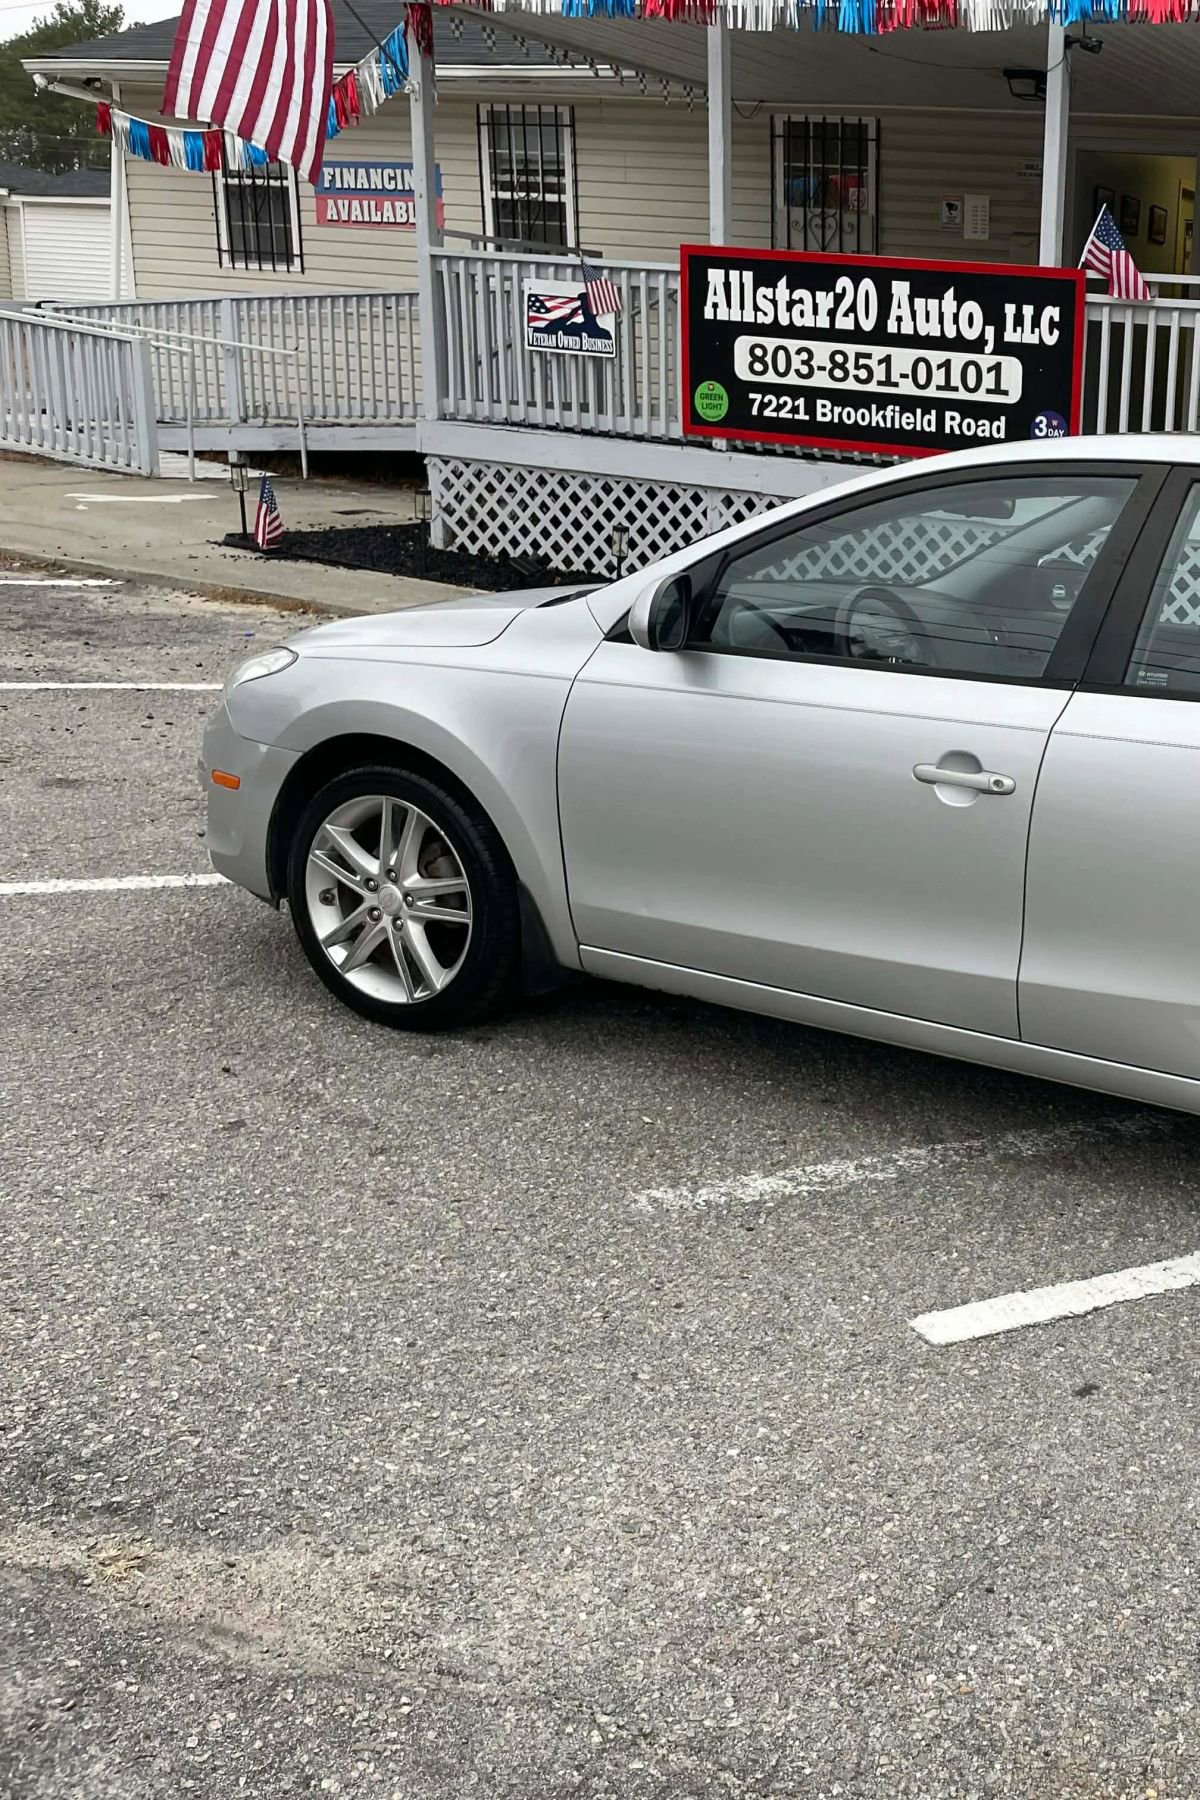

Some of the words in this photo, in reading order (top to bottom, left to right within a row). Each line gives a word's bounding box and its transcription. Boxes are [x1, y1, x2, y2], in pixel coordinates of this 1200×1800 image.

[323, 168, 415, 191] FINANCIN
[327, 199, 416, 224] AVAILABL
[704, 268, 879, 332] Allstar20
[887, 280, 995, 354] Auto,
[1003, 303, 1061, 346] LLC
[747, 343, 1010, 397] 803-851-0101
[700, 393, 723, 401] GREEN
[701, 402, 723, 410] LIGHT
[748, 393, 809, 421] 7221
[816, 400, 937, 433] Brookfield
[944, 412, 1006, 440] Road
[1034, 415, 1048, 437] 3
[1048, 428, 1065, 437] DAY
